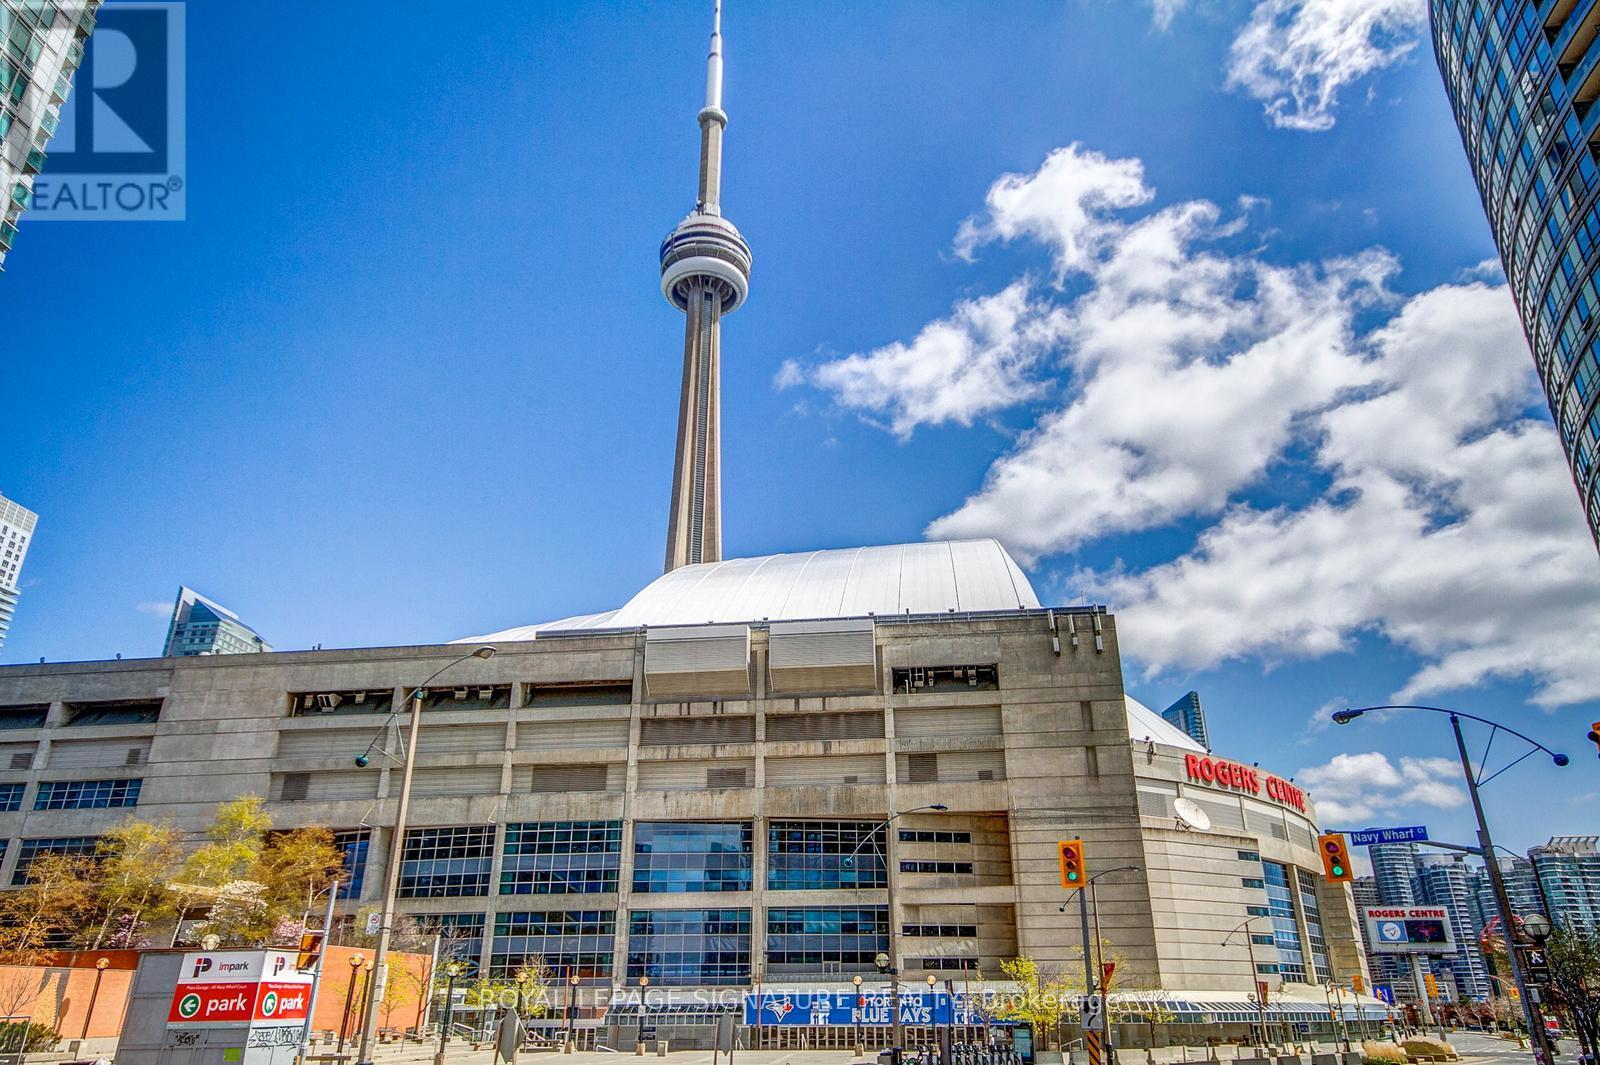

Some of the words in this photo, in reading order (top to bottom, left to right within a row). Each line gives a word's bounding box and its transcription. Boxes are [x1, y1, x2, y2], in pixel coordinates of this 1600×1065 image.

[1186, 754, 1259, 794] ROGERS
[1267, 776, 1307, 813] CENTRE
[1353, 832, 1379, 843] Navy
[1382, 828, 1414, 840] Wharf
[1368, 910, 1406, 918] ROGERS
[1409, 910, 1446, 918] CENTRE
[219, 961, 249, 973] impark
[206, 993, 248, 1016] park
[279, 992, 304, 1015] park
[868, 996, 923, 1007] TORNTO
